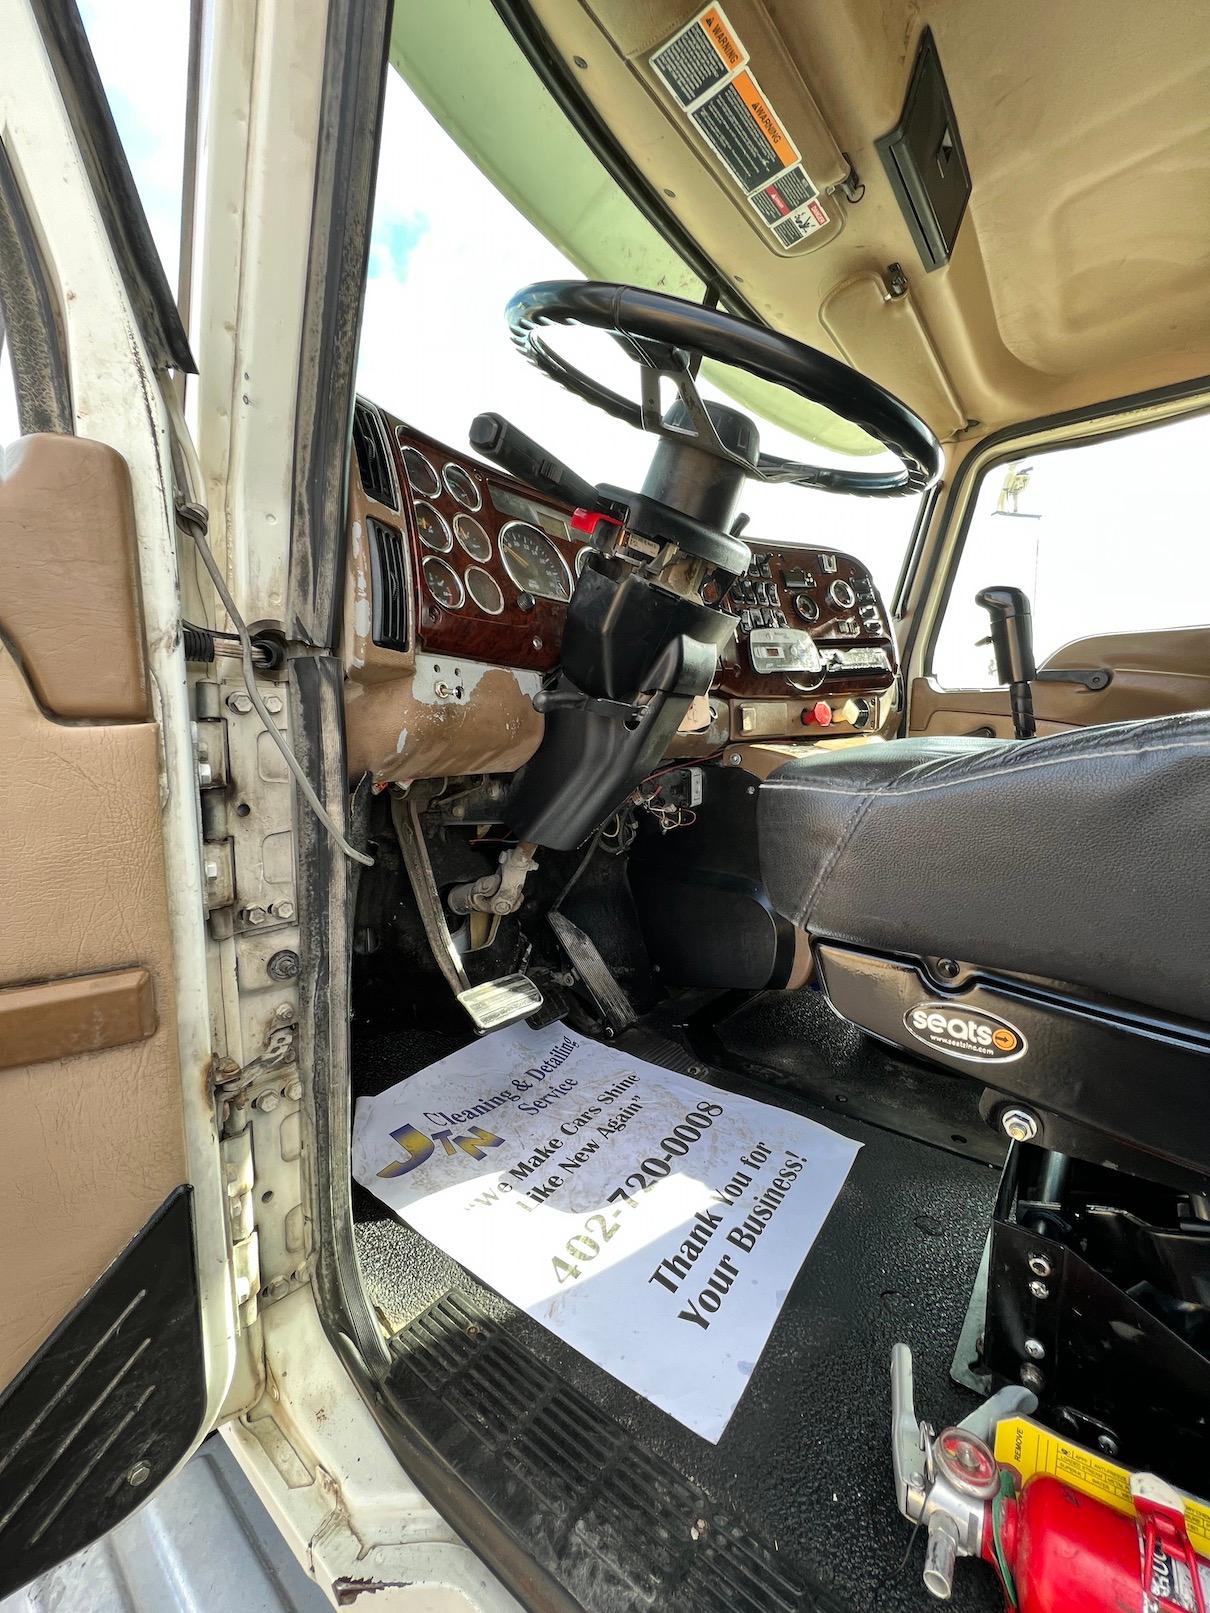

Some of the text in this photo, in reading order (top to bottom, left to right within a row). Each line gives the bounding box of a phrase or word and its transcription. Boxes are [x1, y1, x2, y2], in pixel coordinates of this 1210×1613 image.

[712, 22, 739, 64] WARNING
[756, 105, 782, 144] WARNING
[810, 204, 825, 225] DANGER
[912, 1010, 993, 1046] seats
[929, 1034, 994, 1056] www.seatsinc.com
[423, 1036, 580, 1127] Cleaning & Detailing
[518, 1077, 578, 1116] Service
[509, 1138, 564, 1181] Make
[560, 1104, 602, 1136] Cars
[597, 1072, 641, 1105] Shine
[516, 1174, 564, 1212] Like
[558, 1138, 600, 1174] New
[551, 1101, 724, 1284] 402-720-0008
[648, 1141, 772, 1294] Thank You for
[677, 1150, 808, 1331] Your Business!
[1014, 1427, 1025, 1463] REMOVE
